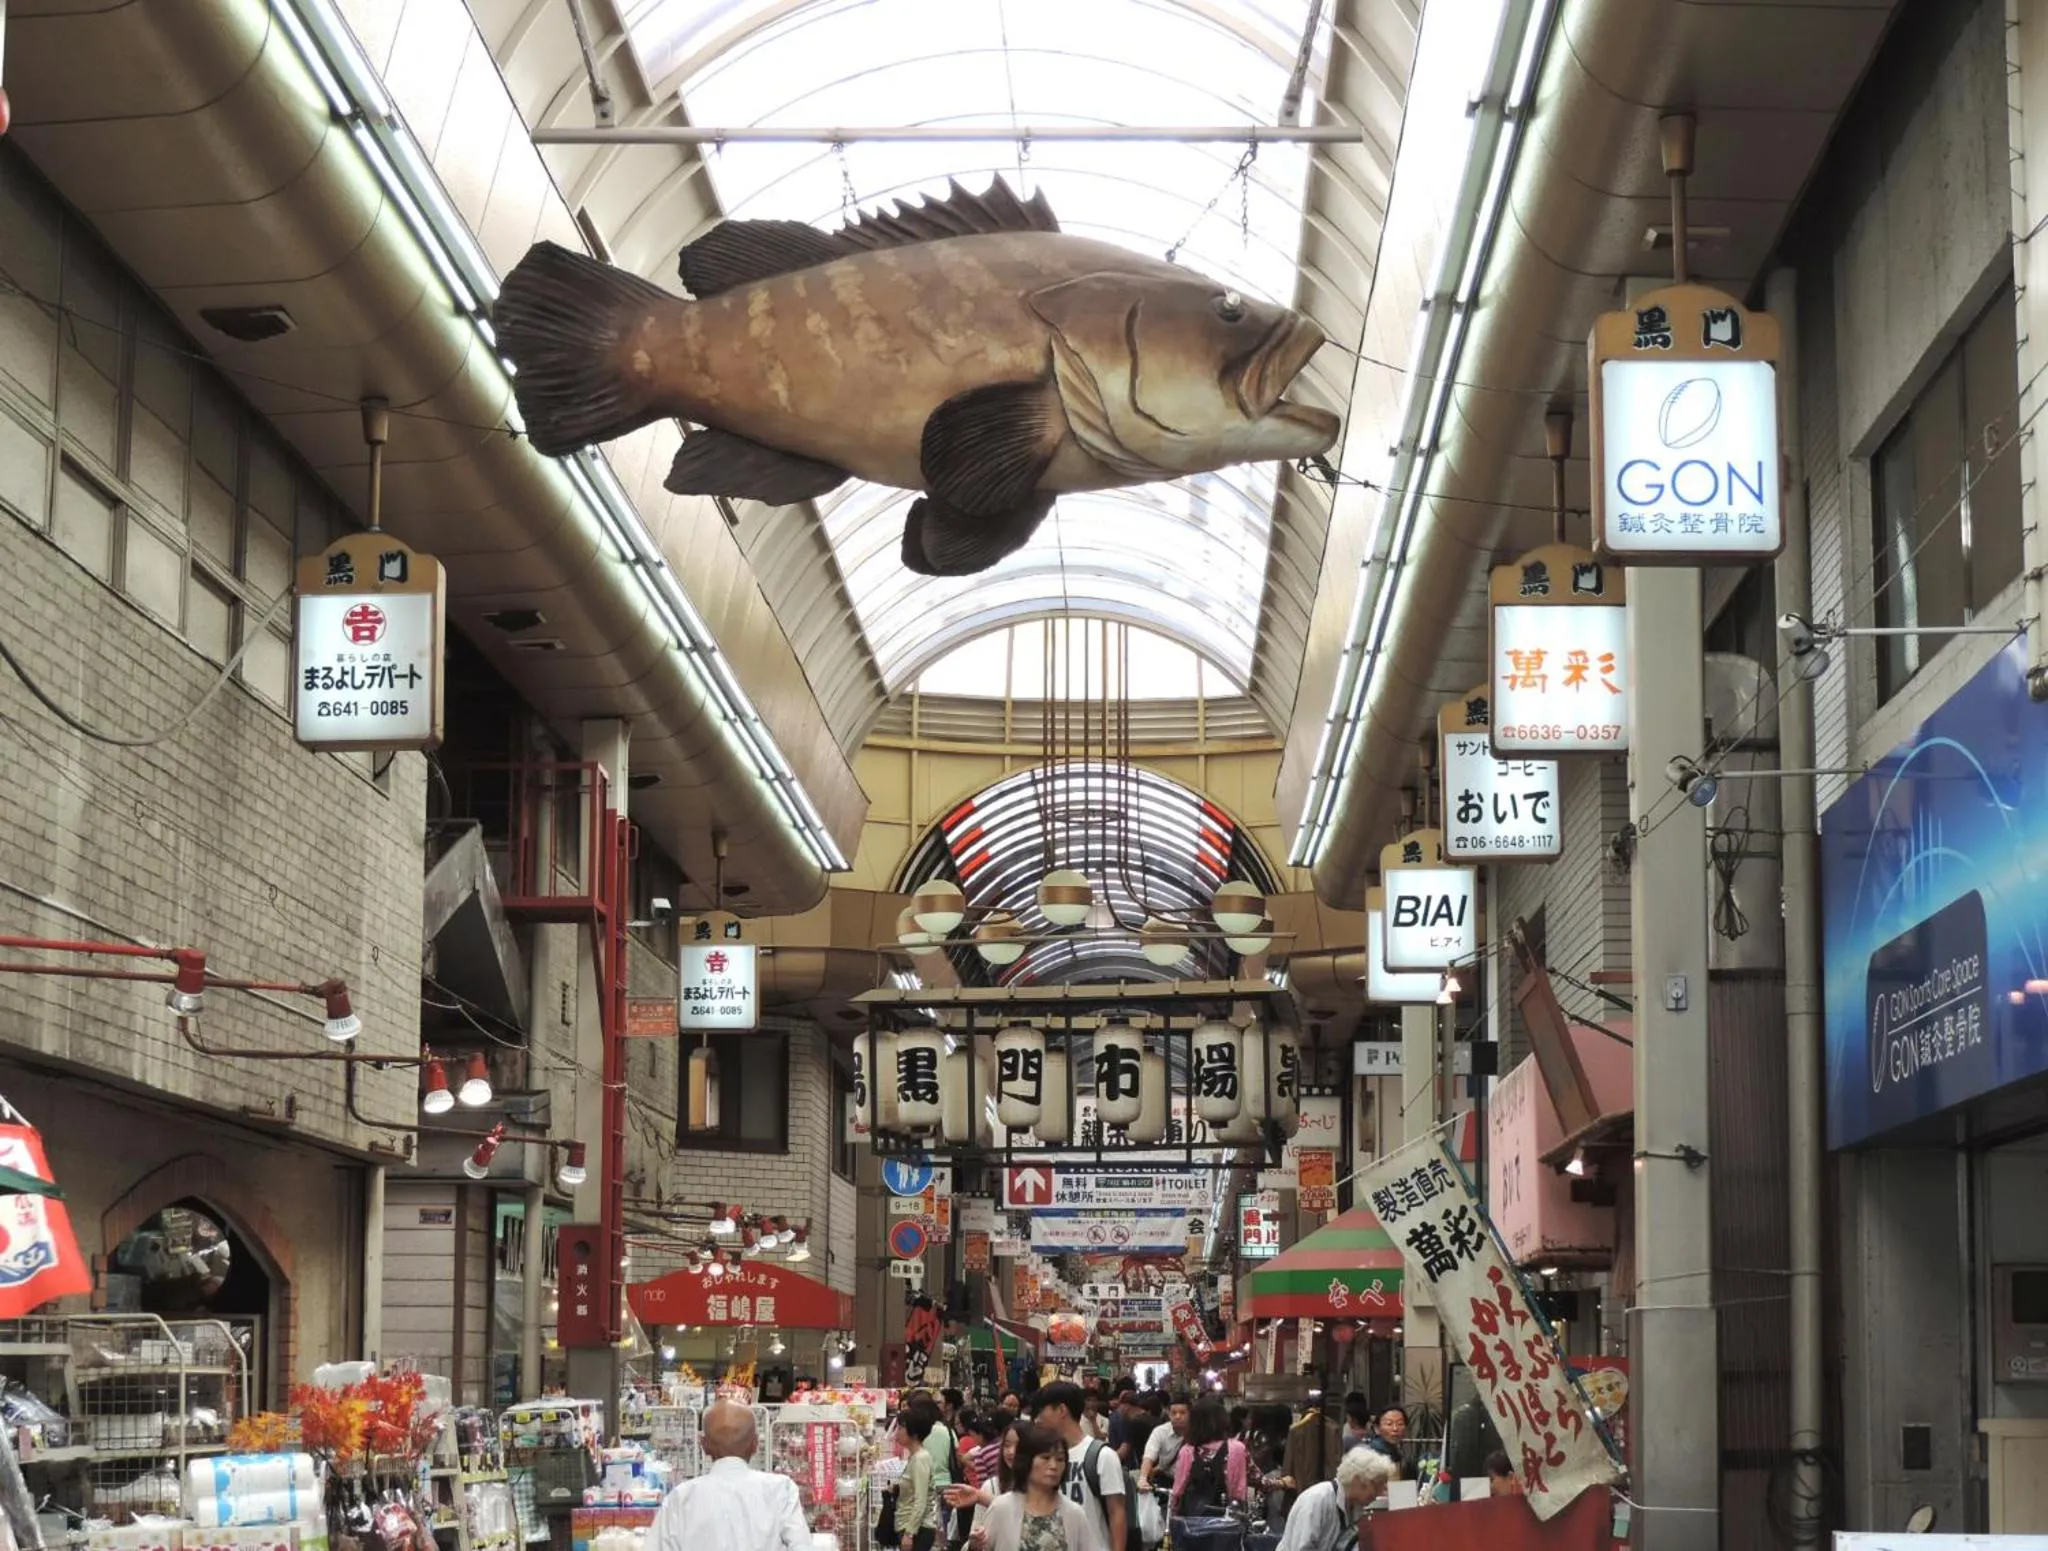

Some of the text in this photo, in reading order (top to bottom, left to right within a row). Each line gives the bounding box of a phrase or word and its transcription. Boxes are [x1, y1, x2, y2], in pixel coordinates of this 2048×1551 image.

[1634, 306, 1742, 349] 黒門
[1617, 459, 1764, 507] GON
[1618, 512, 1766, 535] 鍼灸整骨院
[325, 550, 408, 585] 黒門
[1520, 561, 1603, 596] 黒門
[304, 664, 422, 691] まるよしデパート
[1502, 648, 1622, 694] 萬彩
[1457, 789, 1550, 824] おいで
[1392, 894, 1468, 927] BIAI
[684, 987, 751, 1000] まるよしデパート
[1168, 1179, 1207, 1189] TOILET
[1371, 1158, 1455, 1223] 製造直売
